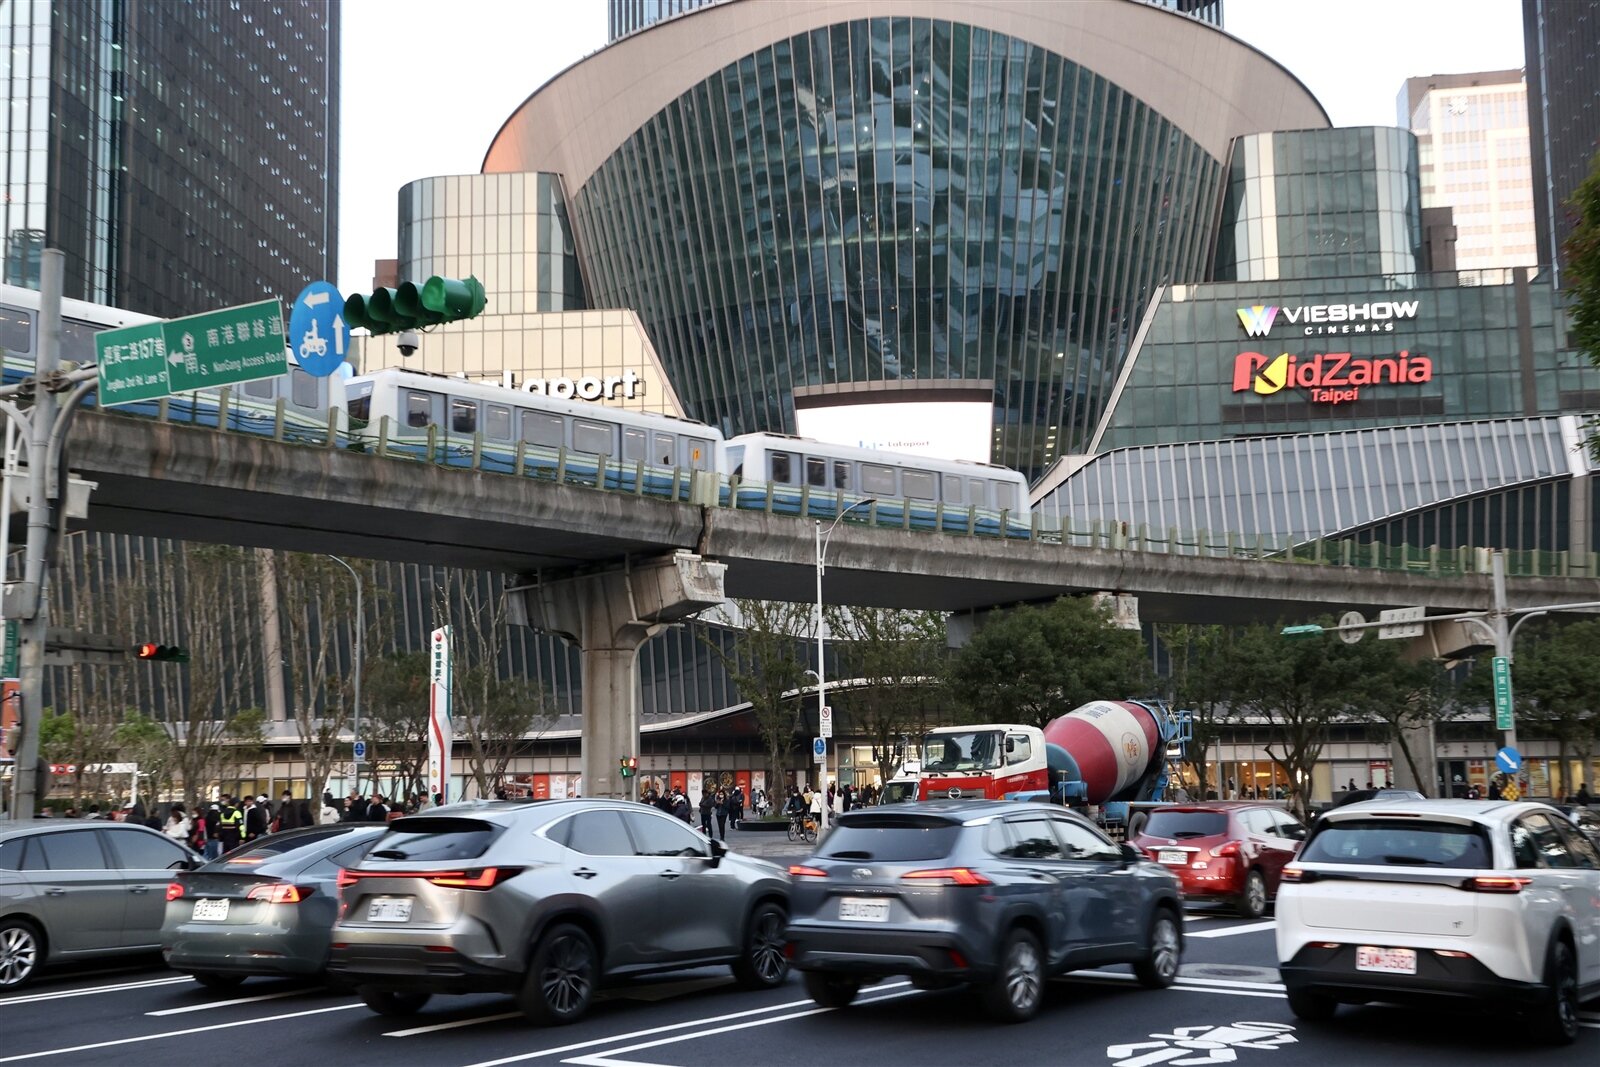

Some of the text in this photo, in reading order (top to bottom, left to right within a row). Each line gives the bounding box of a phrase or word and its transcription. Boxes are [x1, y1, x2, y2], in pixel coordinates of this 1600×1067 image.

[1283, 301, 1419, 323] VIESHOW
[1304, 322, 1394, 335] CINEMAS
[184, 352, 199, 375] 南
[1232, 350, 1433, 394] KidZania
[1311, 386, 1359, 405] Taipei
